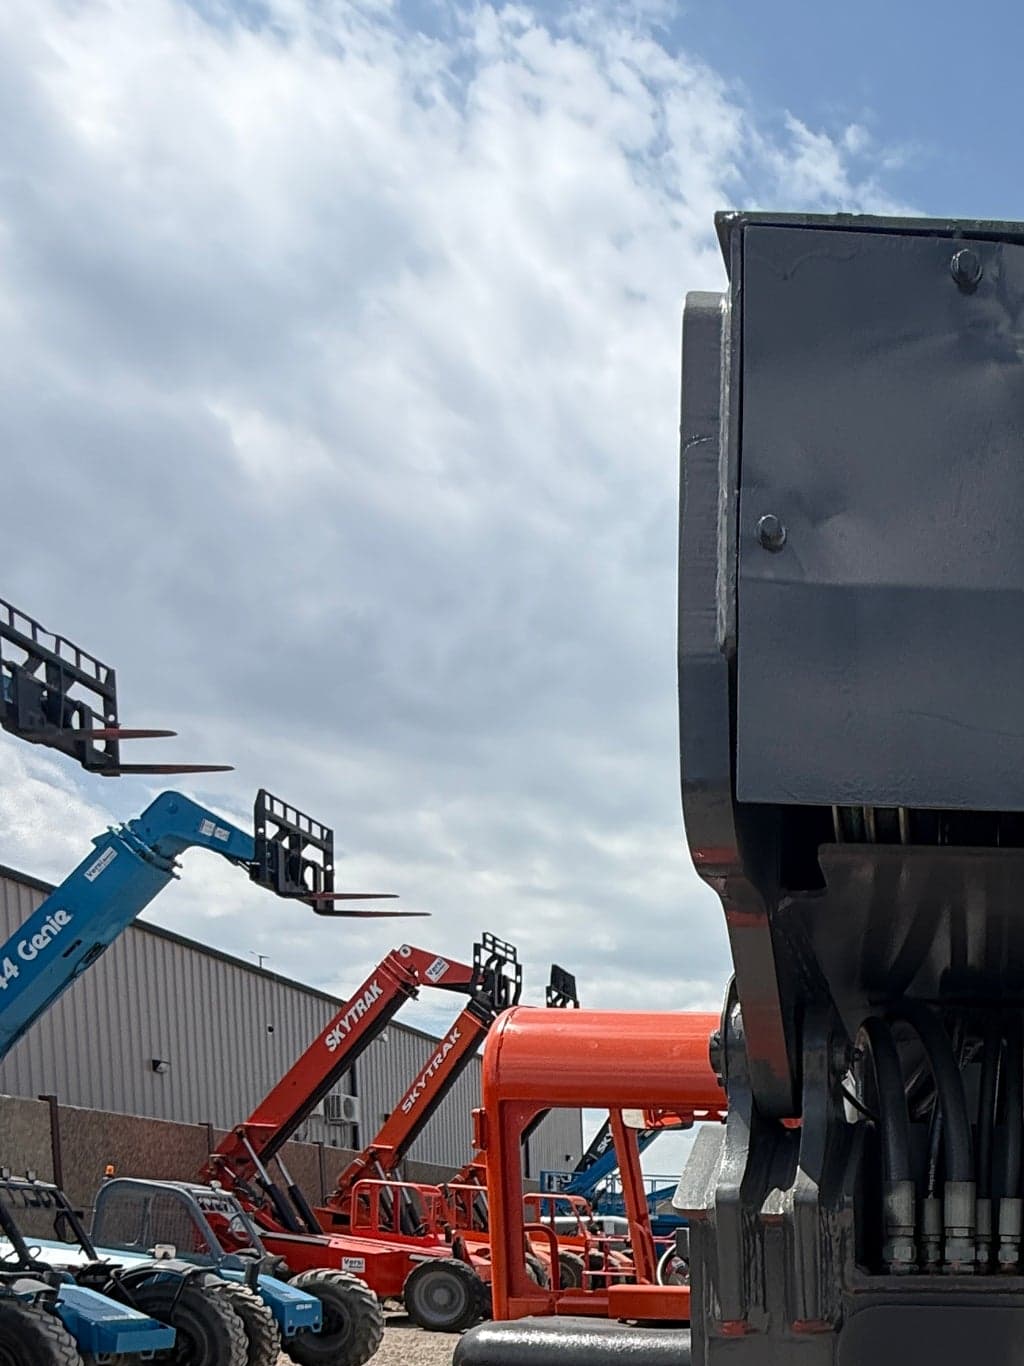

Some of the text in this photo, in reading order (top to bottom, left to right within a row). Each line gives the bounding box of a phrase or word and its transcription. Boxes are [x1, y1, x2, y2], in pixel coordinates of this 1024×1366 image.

[17, 910, 73, 961] Genie
[325, 979, 384, 1053] SKYTRAK
[401, 1027, 462, 1115] SKYTRAK
